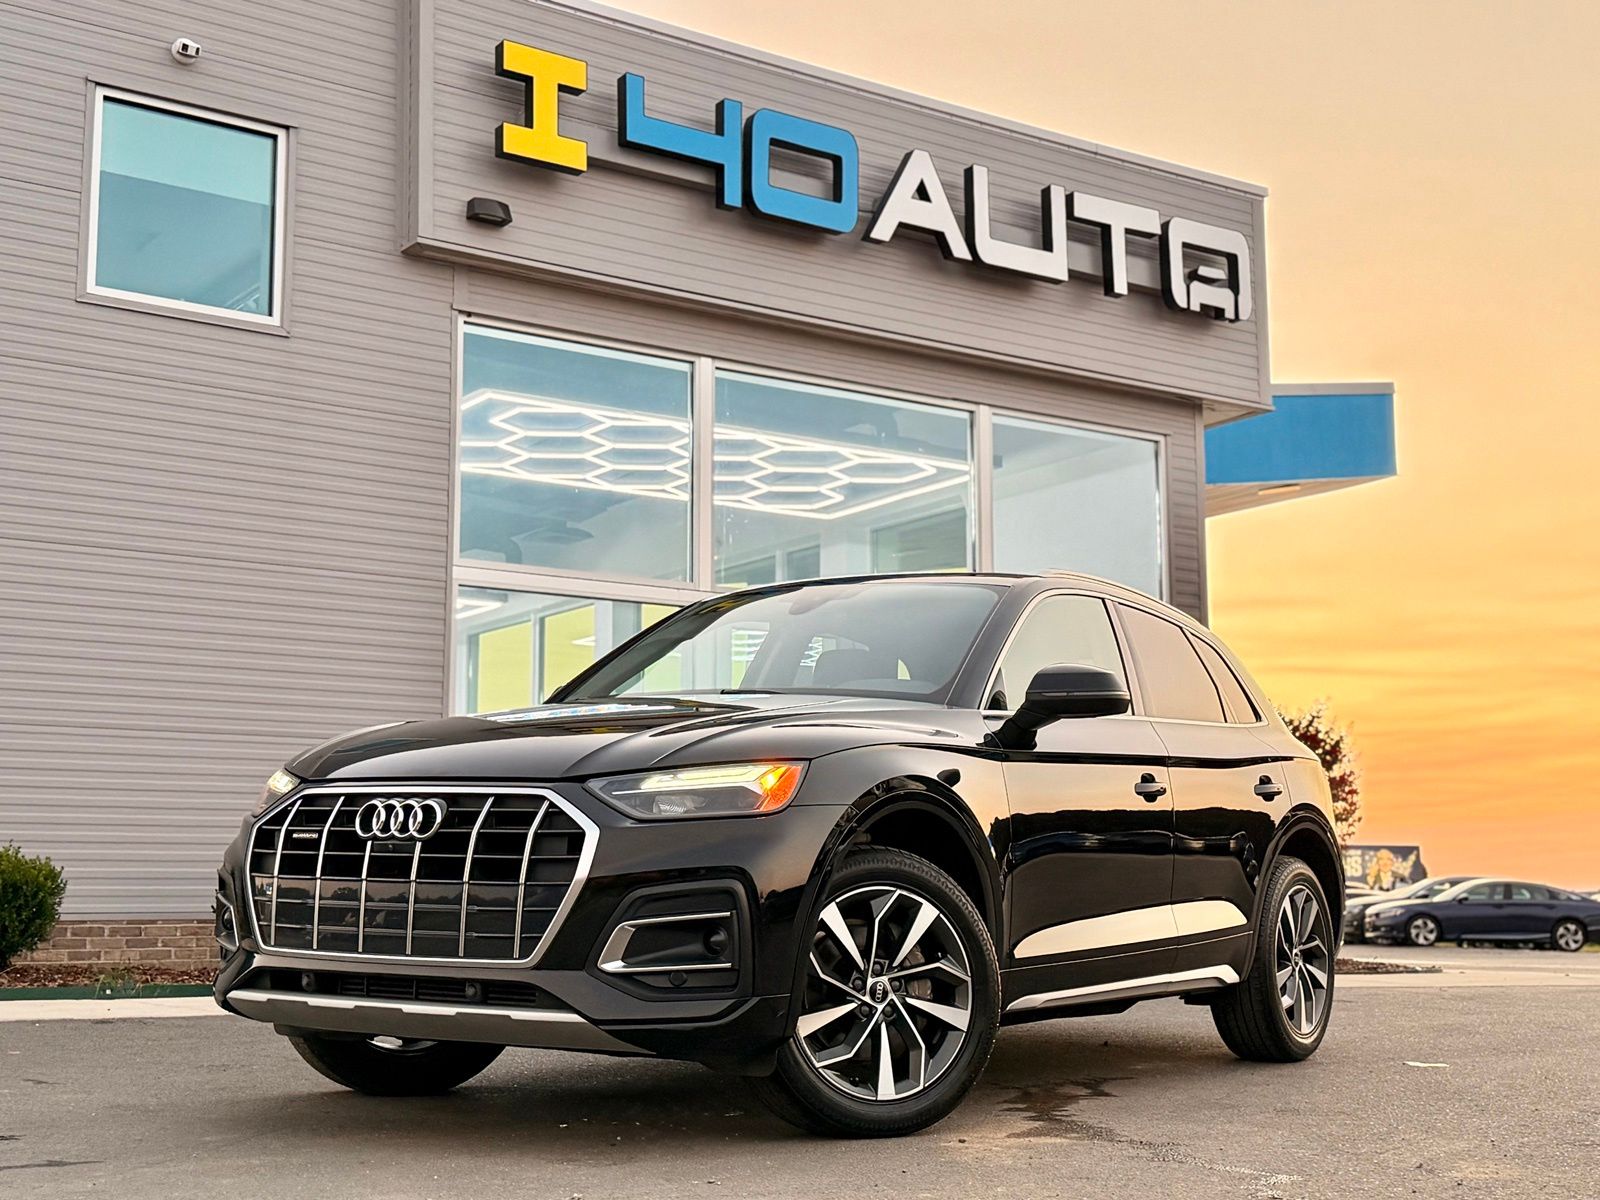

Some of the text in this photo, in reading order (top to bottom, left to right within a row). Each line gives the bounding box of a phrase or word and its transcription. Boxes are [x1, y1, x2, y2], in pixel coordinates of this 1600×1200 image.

[497, 40, 1252, 321] I 40 AUTO
